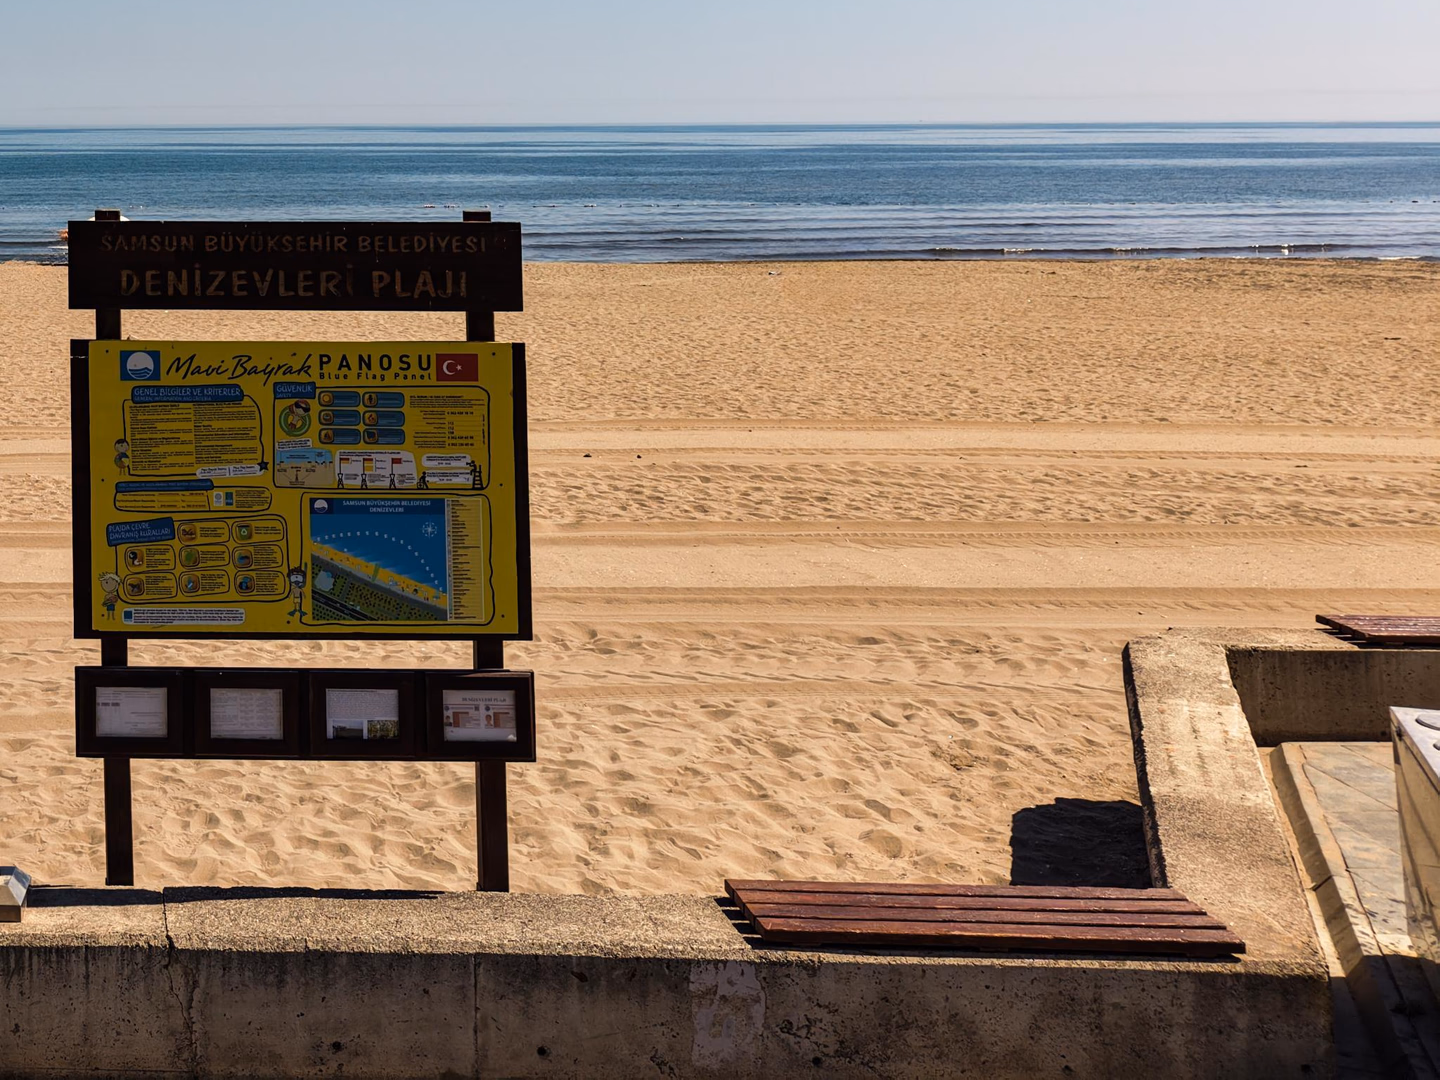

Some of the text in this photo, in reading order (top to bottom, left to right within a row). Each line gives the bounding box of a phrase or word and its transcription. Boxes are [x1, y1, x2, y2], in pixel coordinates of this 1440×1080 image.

[101, 234, 195, 252] SAMSUN
[371, 268, 467, 298] PLAJI
[166, 352, 432, 387] Mavi Bayrak PANOSU
[319, 371, 432, 382] Blue Flag Panel
[134, 388, 158, 396] GENEL
[160, 387, 192, 396] BİLGİLER
[192, 387, 202, 396] VE
